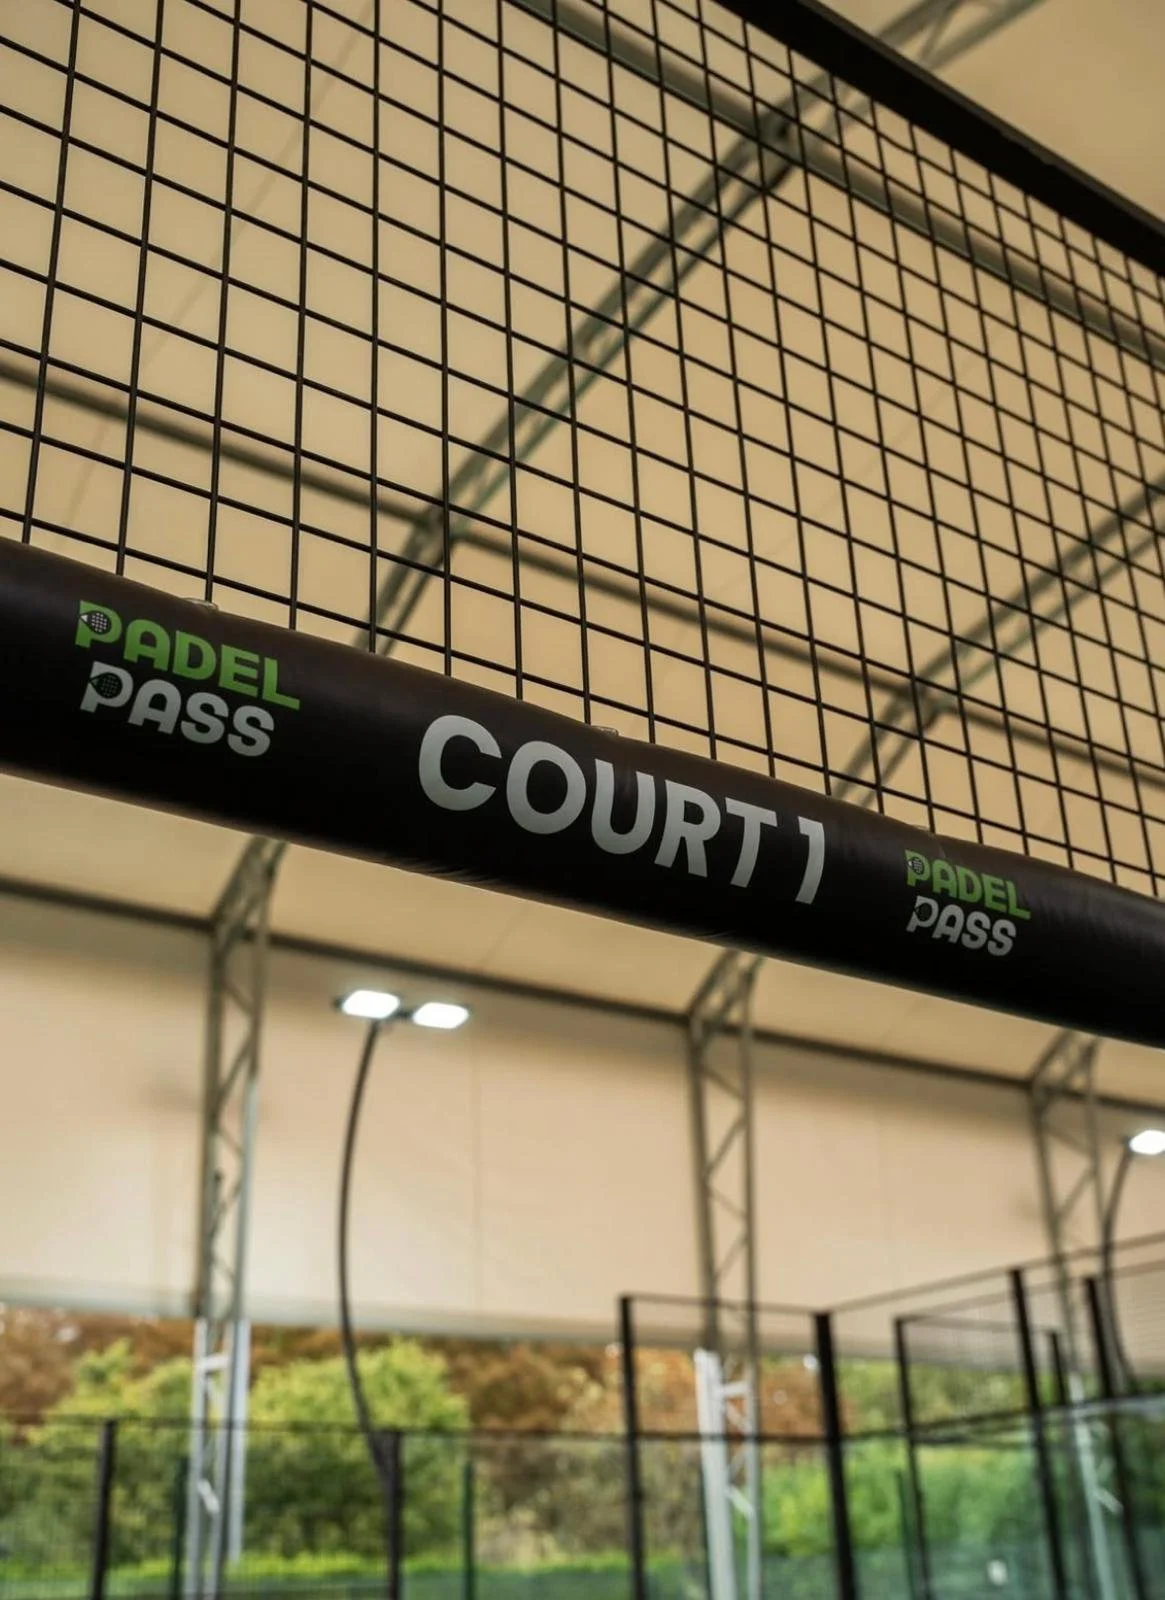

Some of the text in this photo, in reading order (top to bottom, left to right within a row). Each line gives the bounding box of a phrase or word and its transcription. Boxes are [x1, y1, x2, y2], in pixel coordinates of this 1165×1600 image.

[75, 600, 300, 710] PADEL
[80, 660, 275, 757] PASS
[418, 714, 826, 905] COURT 1
[904, 849, 1032, 920] PADEL
[906, 895, 1017, 957] PASS
